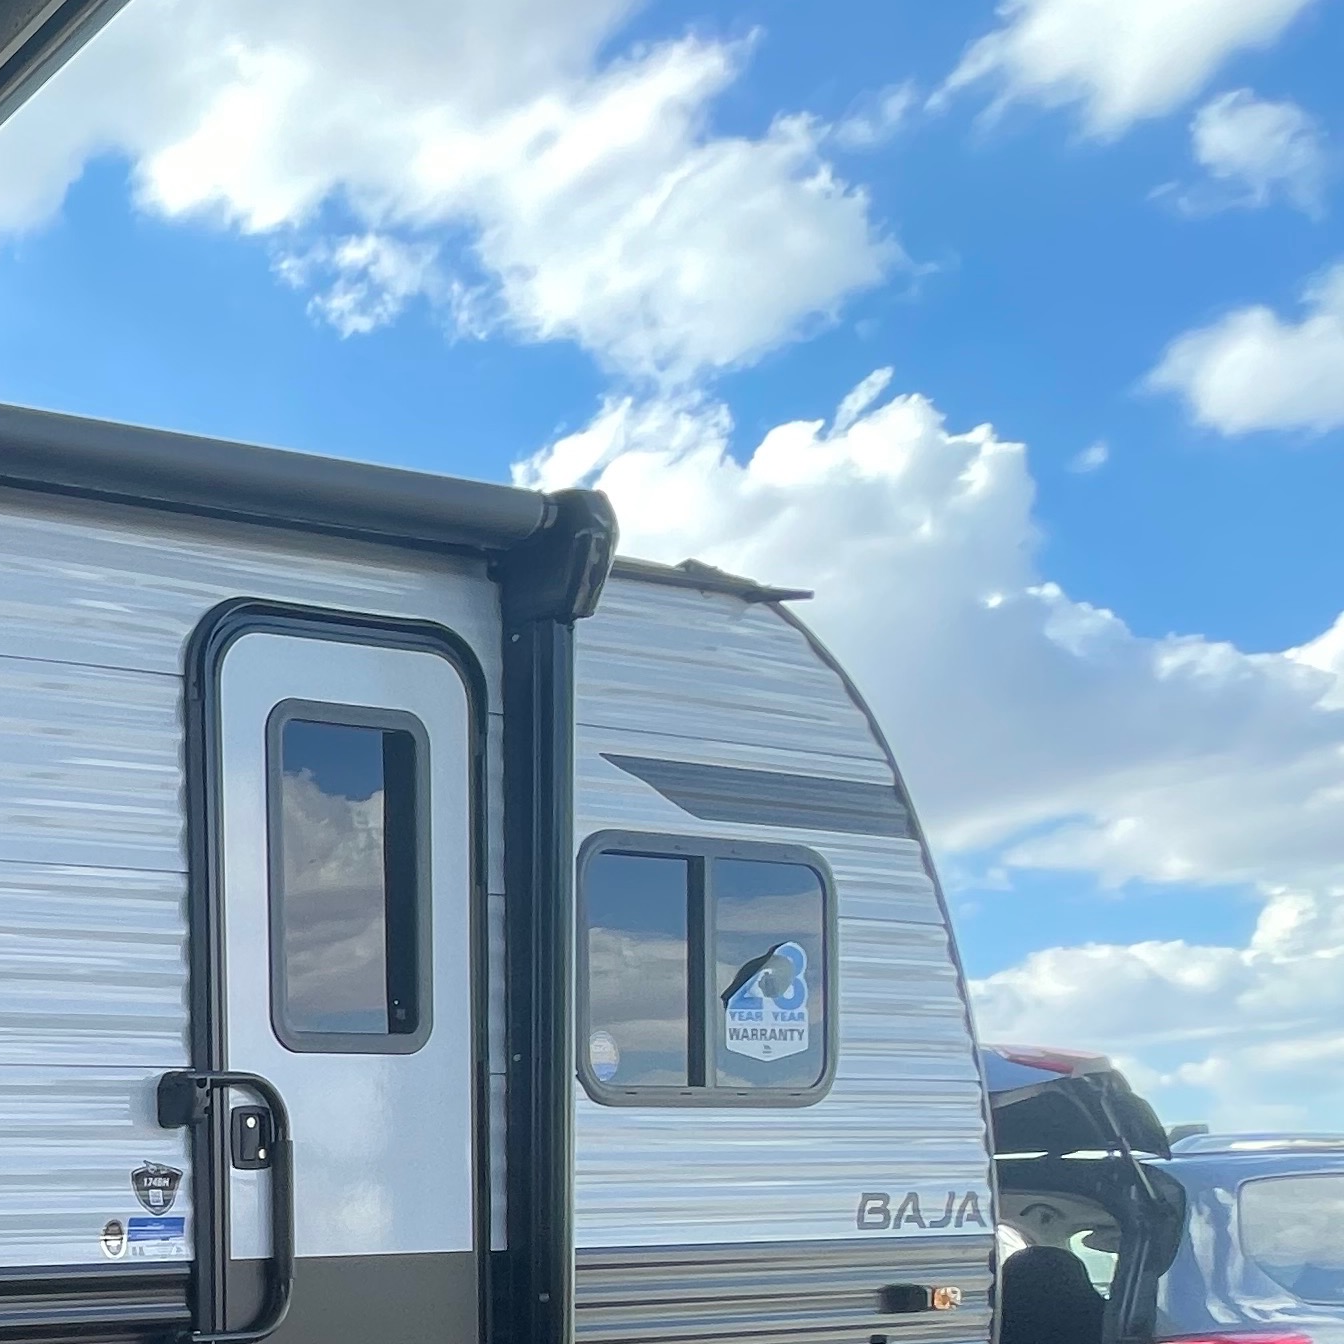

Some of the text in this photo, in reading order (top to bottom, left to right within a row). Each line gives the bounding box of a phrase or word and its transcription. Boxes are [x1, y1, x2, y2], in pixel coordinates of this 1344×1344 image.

[729, 1011, 805, 1021] YEAR YEAR
[728, 1028, 805, 1041] WARRANTY
[857, 1191, 987, 1230] BAJA
